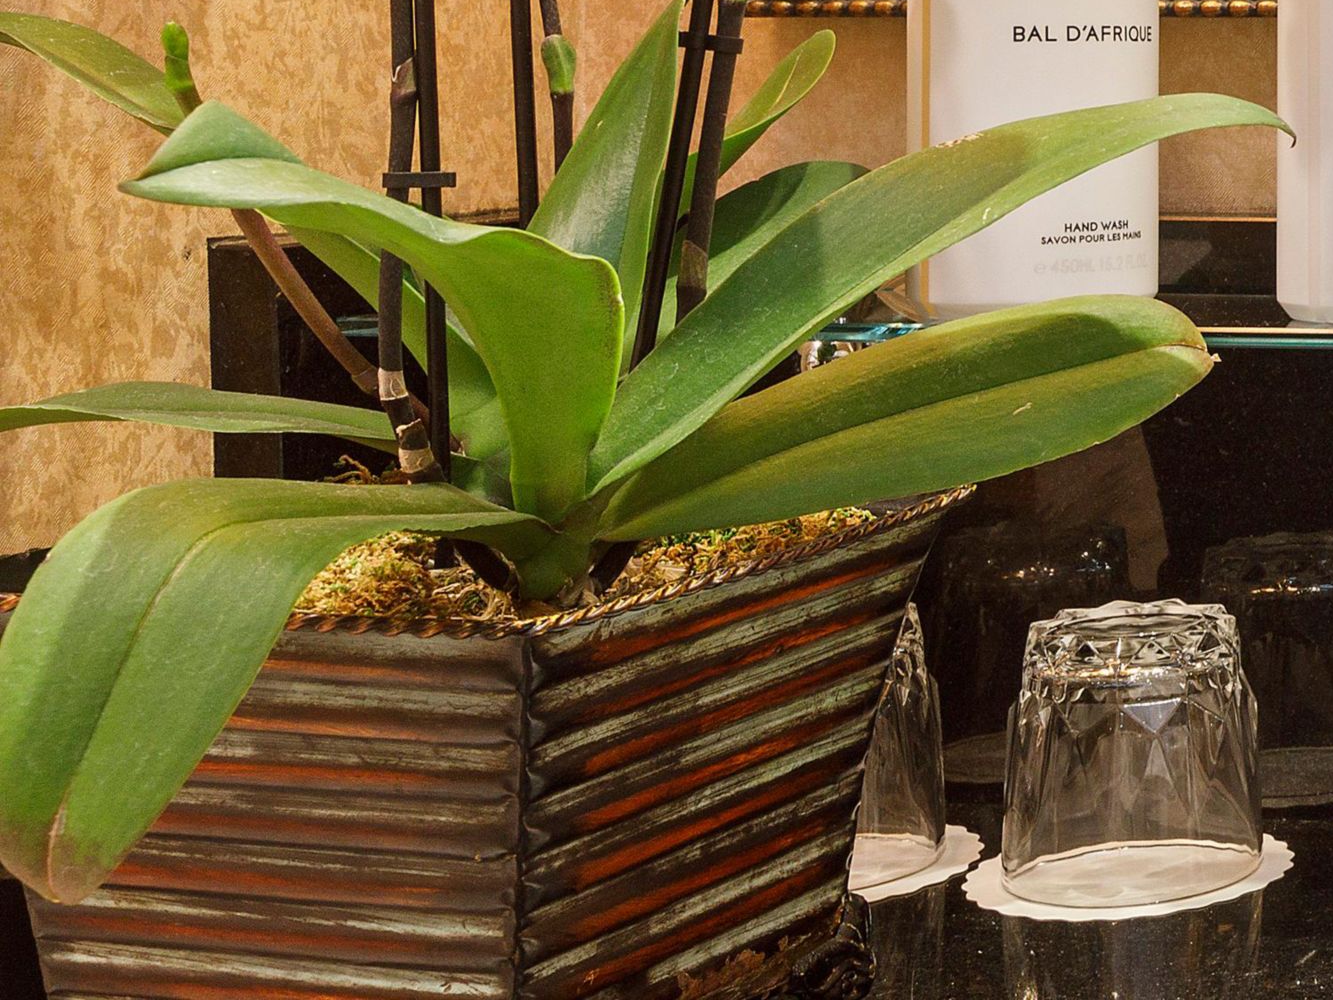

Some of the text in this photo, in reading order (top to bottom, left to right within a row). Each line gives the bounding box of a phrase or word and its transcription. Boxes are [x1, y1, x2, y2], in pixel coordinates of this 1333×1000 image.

[1012, 24, 1153, 43] BAL D'AFRIQUE
[1064, 220, 1129, 233] HAND WASH
[1041, 230, 1142, 246] SAVON POUR LES MAINS
